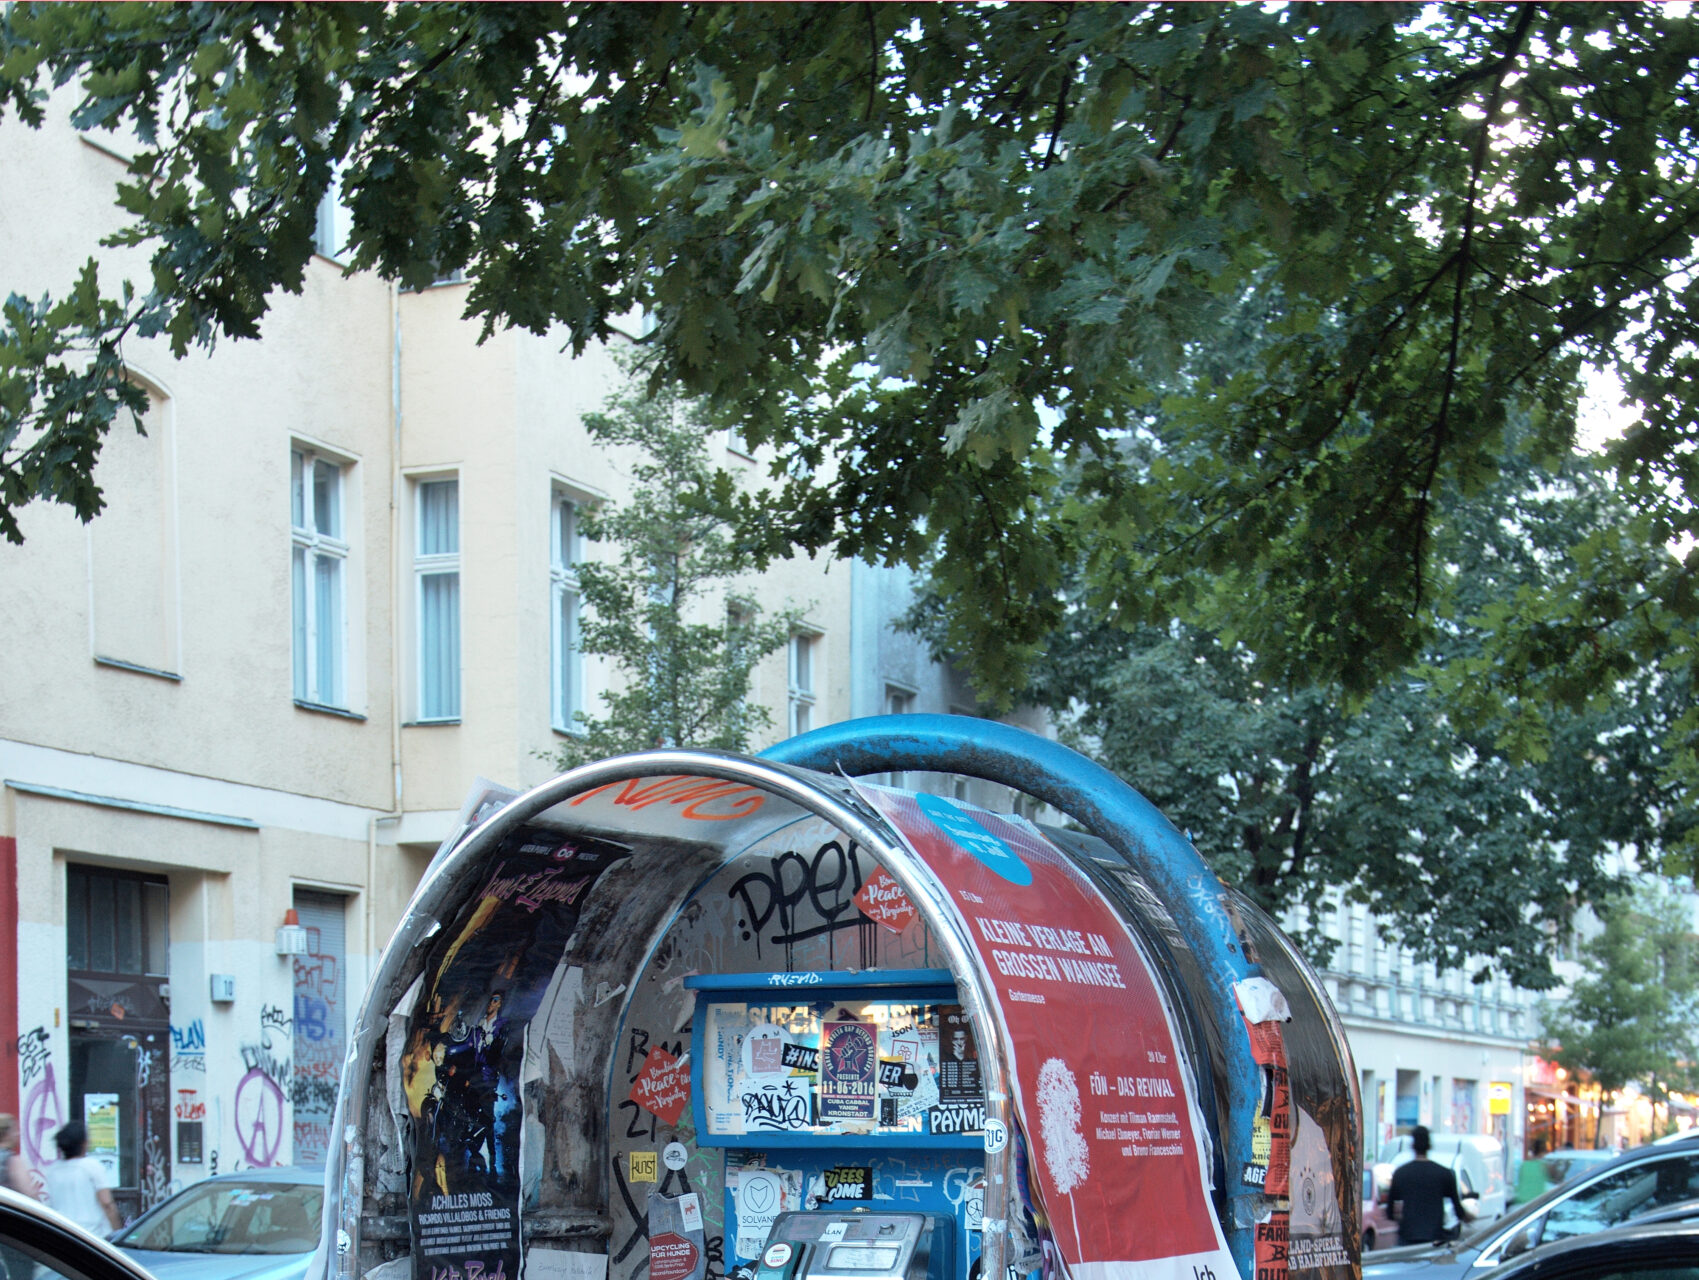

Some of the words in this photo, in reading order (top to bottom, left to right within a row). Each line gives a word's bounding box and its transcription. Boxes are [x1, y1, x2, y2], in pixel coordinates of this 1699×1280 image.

[868, 884, 906, 905] Peace
[975, 917, 1032, 947] KLEINE
[1025, 924, 1091, 955] VERLAGE
[1086, 933, 1114, 959] AM
[992, 949, 1062, 982] GROSSEN
[1057, 957, 1127, 989] WANNSEE
[641, 1073, 676, 1096] Peace
[1089, 1071, 1108, 1096] FÖN
[1117, 1076, 1135, 1097] DAS
[1136, 1077, 1176, 1098] REVIVAL
[1096, 1127, 1116, 1140] Michael
[1160, 1128, 1181, 1140] Werner
[1121, 1145, 1132, 1156] und
[431, 1193, 468, 1210] ACHILLES
[469, 1192, 493, 1208] MOSS
[418, 1212, 443, 1225] RICARDO
[443, 1210, 478, 1223] VILLALOBOS
[484, 1208, 511, 1220] FRIENDS
[651, 1243, 690, 1251] UPCYCLING
[666, 1249, 690, 1257] HUNDE
